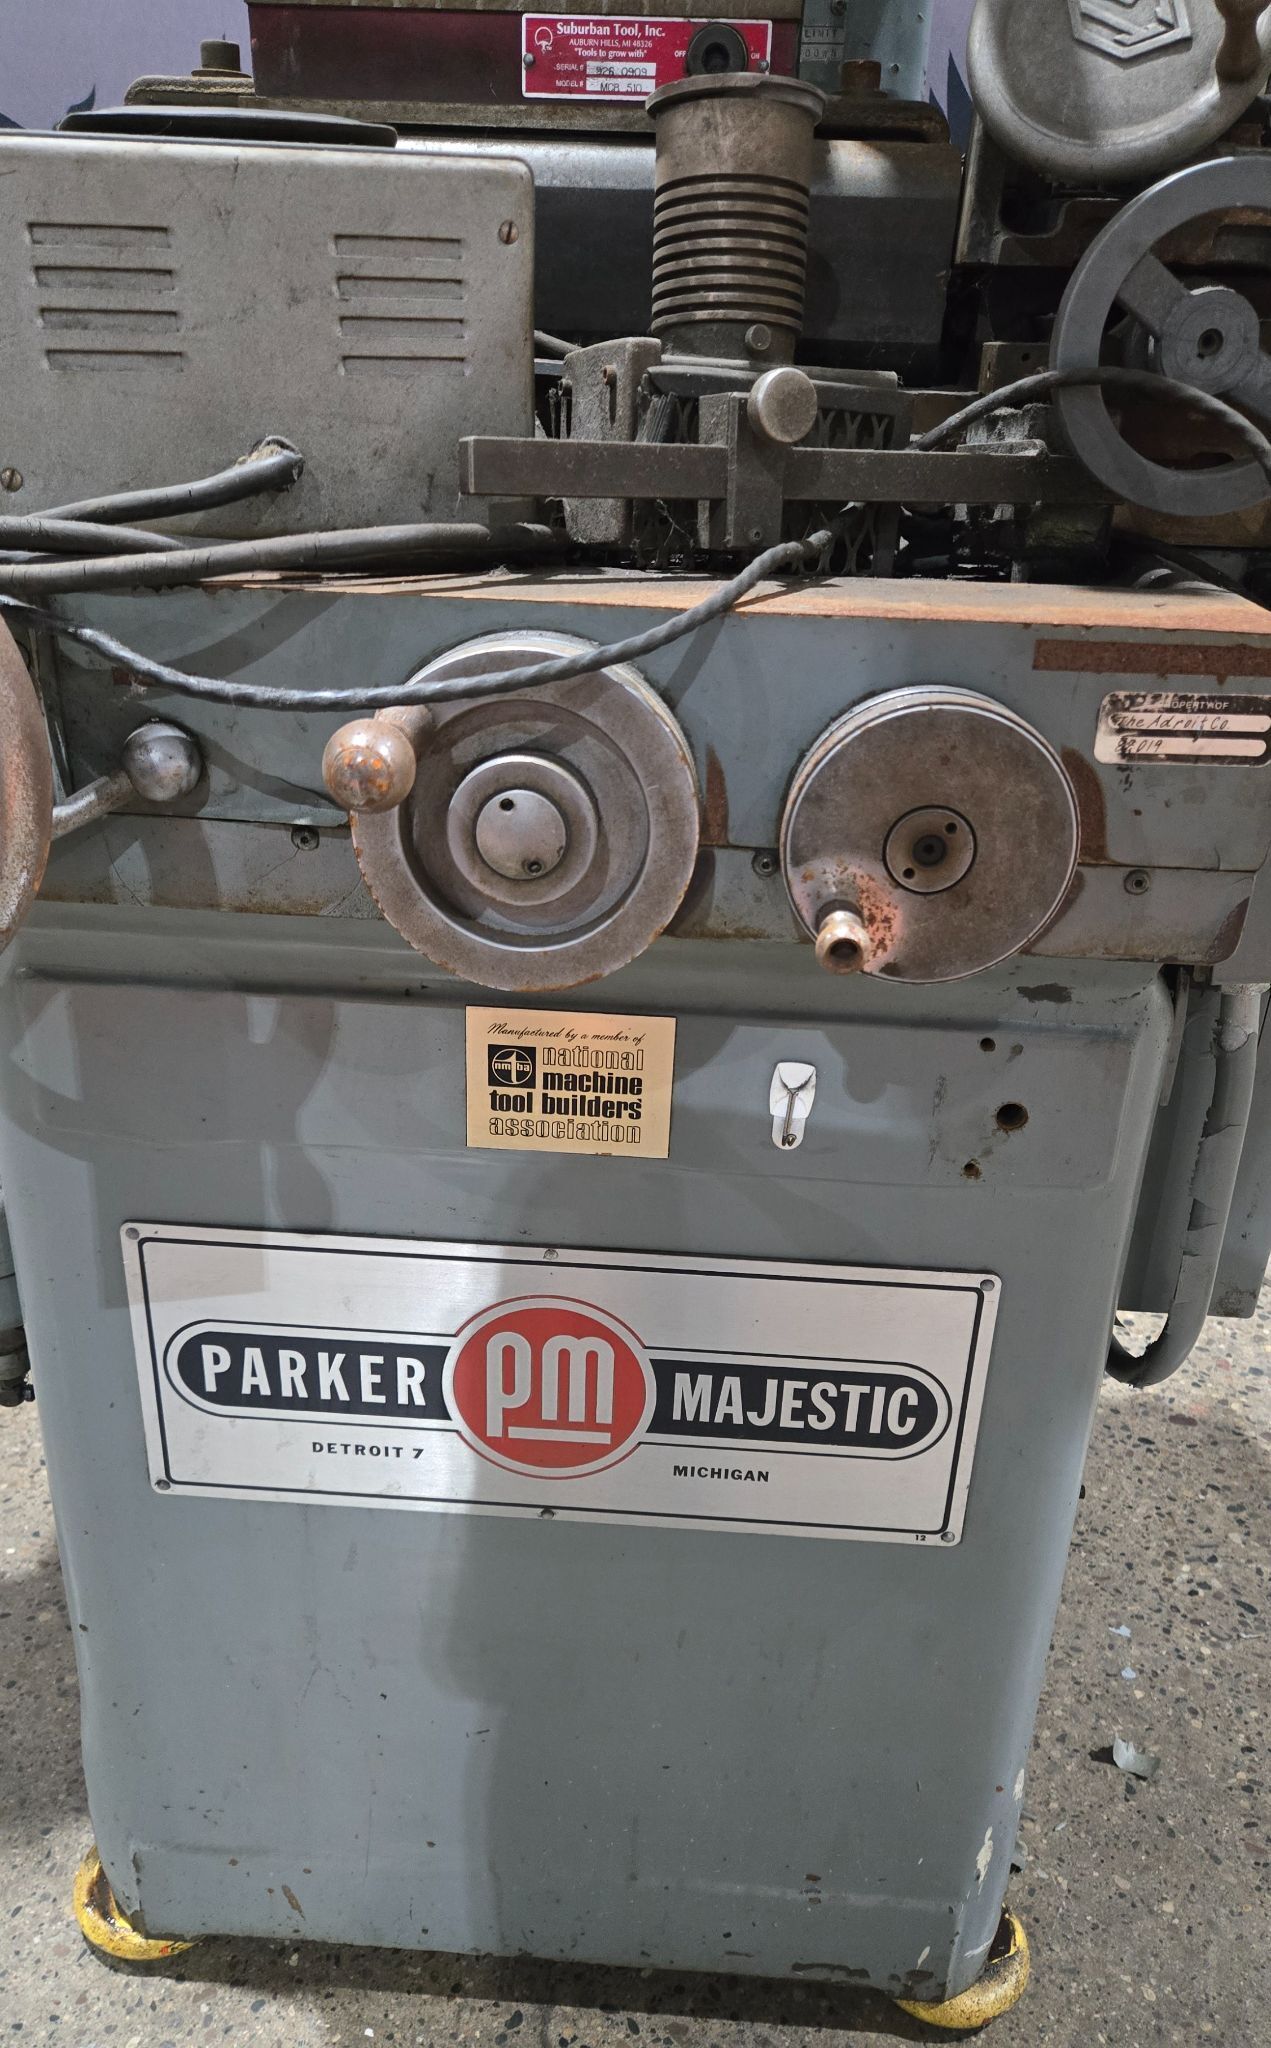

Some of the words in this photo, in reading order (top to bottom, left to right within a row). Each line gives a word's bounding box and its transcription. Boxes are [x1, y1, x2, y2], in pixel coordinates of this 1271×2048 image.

[556, 21, 610, 36] Suburban
[614, 23, 641, 38] Tool,
[645, 24, 666, 36] Inc.
[569, 39, 600, 47] AUBURN
[600, 40, 620, 48] HILLS,
[622, 40, 631, 48] MI
[633, 40, 652, 48] 48326
[574, 48, 598, 56] "Tools
[599, 49, 607, 57] to
[608, 50, 628, 60] grow
[628, 49, 648, 58] with"
[556, 62, 578, 71] SERIAL
[556, 80, 578, 88] MODEL
[626, 83, 642, 93] 510
[1159, 700, 1214, 710] OPERTY
[1215, 702, 1229, 710] OF
[1117, 715, 1145, 727] The
[488, 1022, 562, 1040] Manufactured
[564, 1028, 578, 1042] by
[591, 1030, 630, 1042] member
[632, 1034, 647, 1046] of
[542, 1046, 644, 1071] national
[542, 1071, 642, 1096] machine
[489, 1089, 533, 1114] tool
[542, 1092, 642, 1120] builders'
[489, 1116, 641, 1144] association
[200, 1344, 426, 1406] PARKER
[672, 1372, 919, 1436] MAJESTIC
[312, 1441, 404, 1458] DETROIT
[412, 1448, 424, 1460] 7
[673, 1464, 770, 1483] MICHIGAN
[915, 1534, 926, 1542] 12
